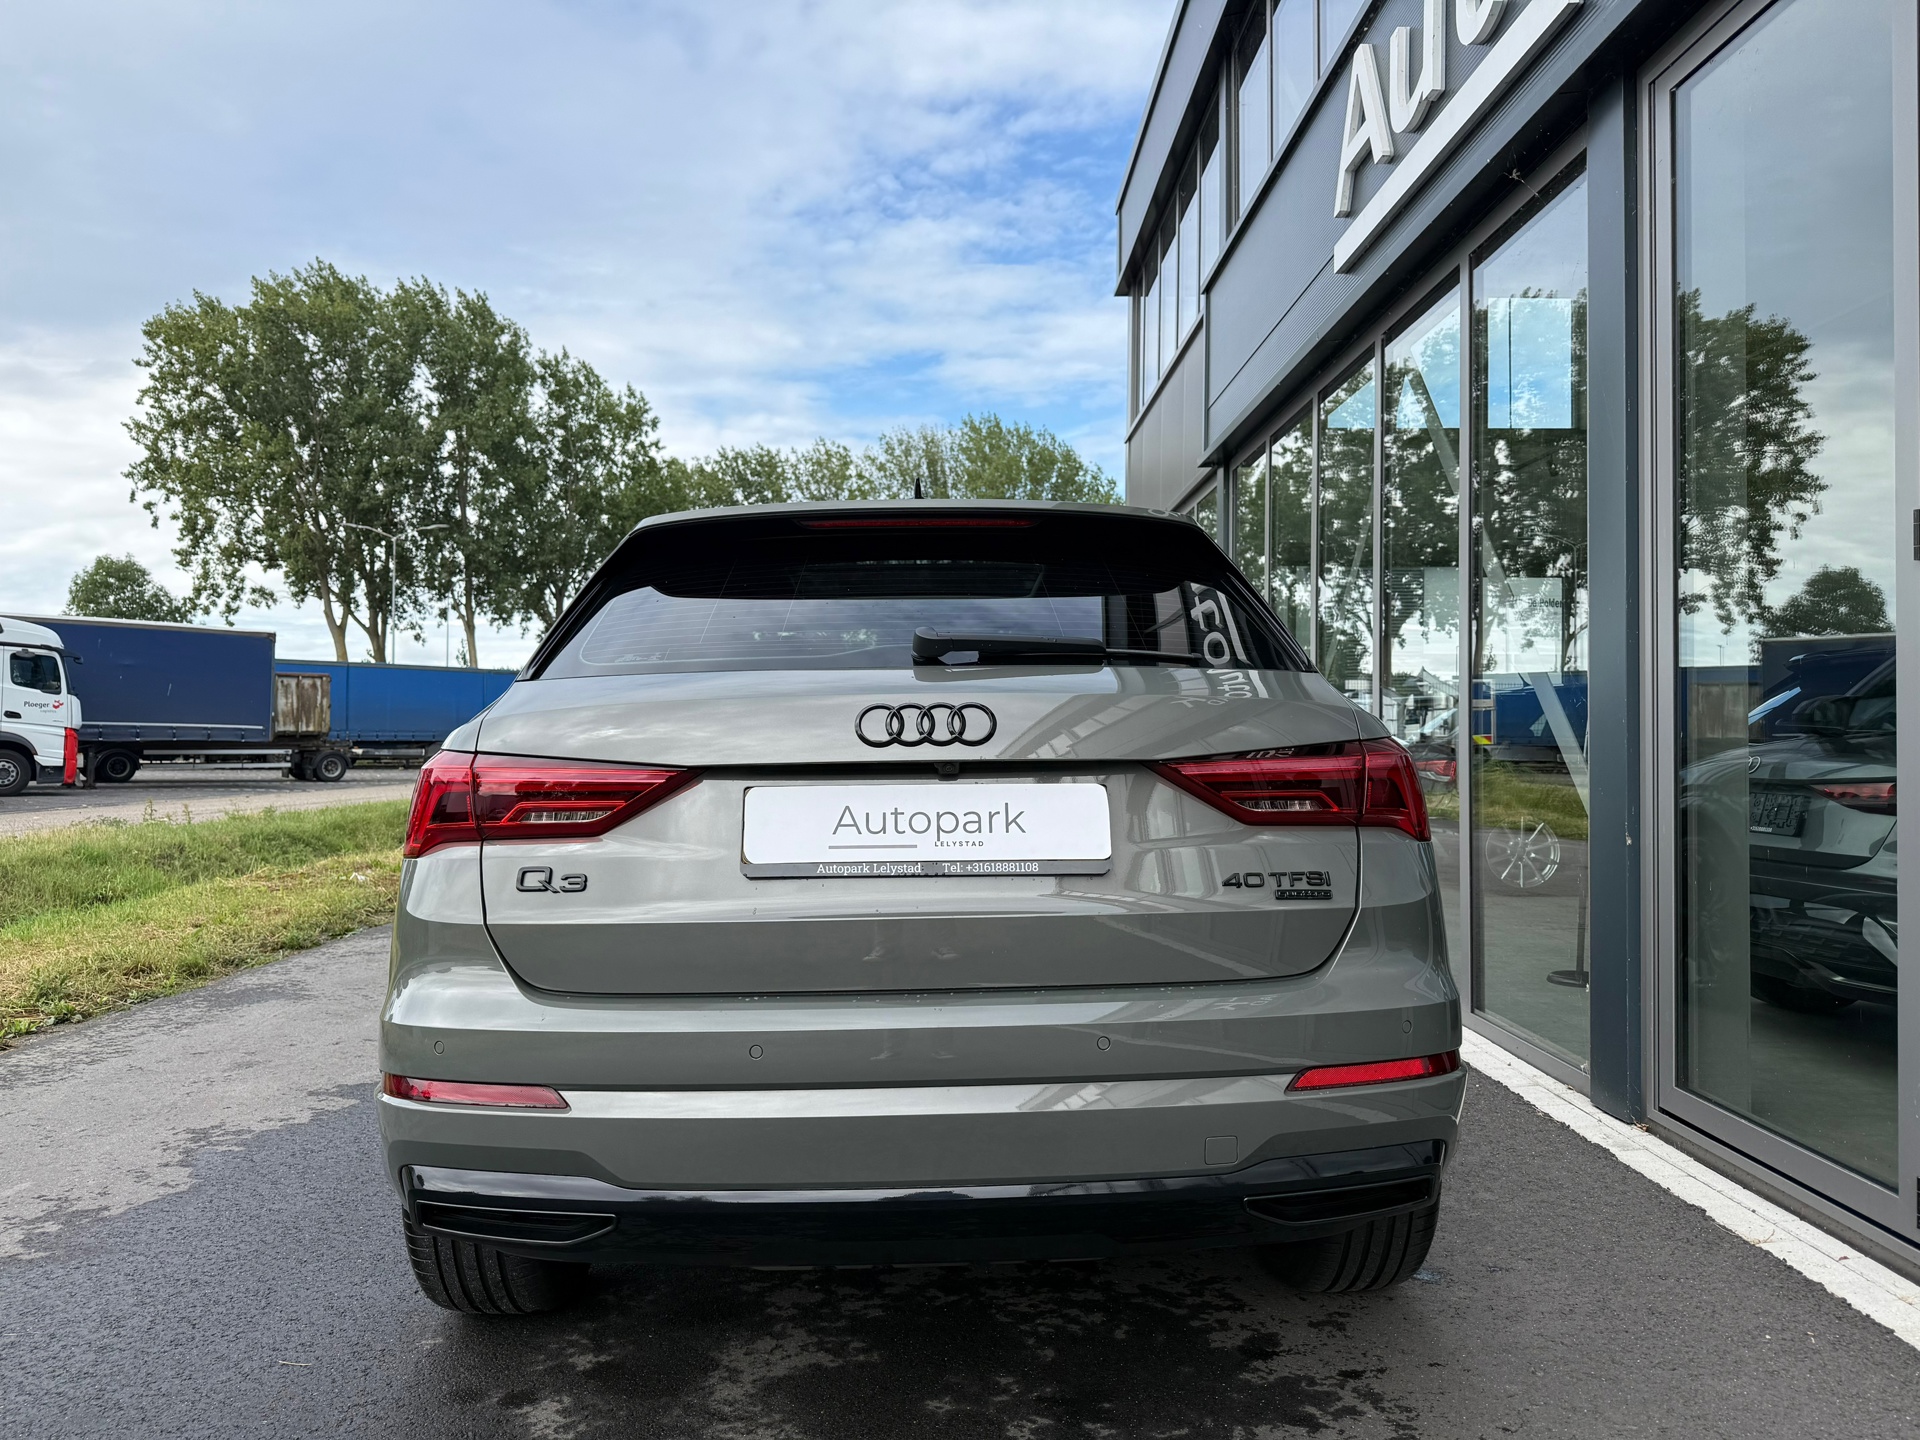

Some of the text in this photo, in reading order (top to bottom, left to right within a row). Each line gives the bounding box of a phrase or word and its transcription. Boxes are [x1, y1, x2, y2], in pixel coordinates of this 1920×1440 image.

[832, 802, 1027, 842] Autopark
[934, 840, 985, 848] LELYSTAD
[816, 862, 1039, 875] Autopark Lelystad Tel: +31618881108
[516, 866, 588, 894] Q3
[1222, 870, 1332, 888] 40 TFSI
